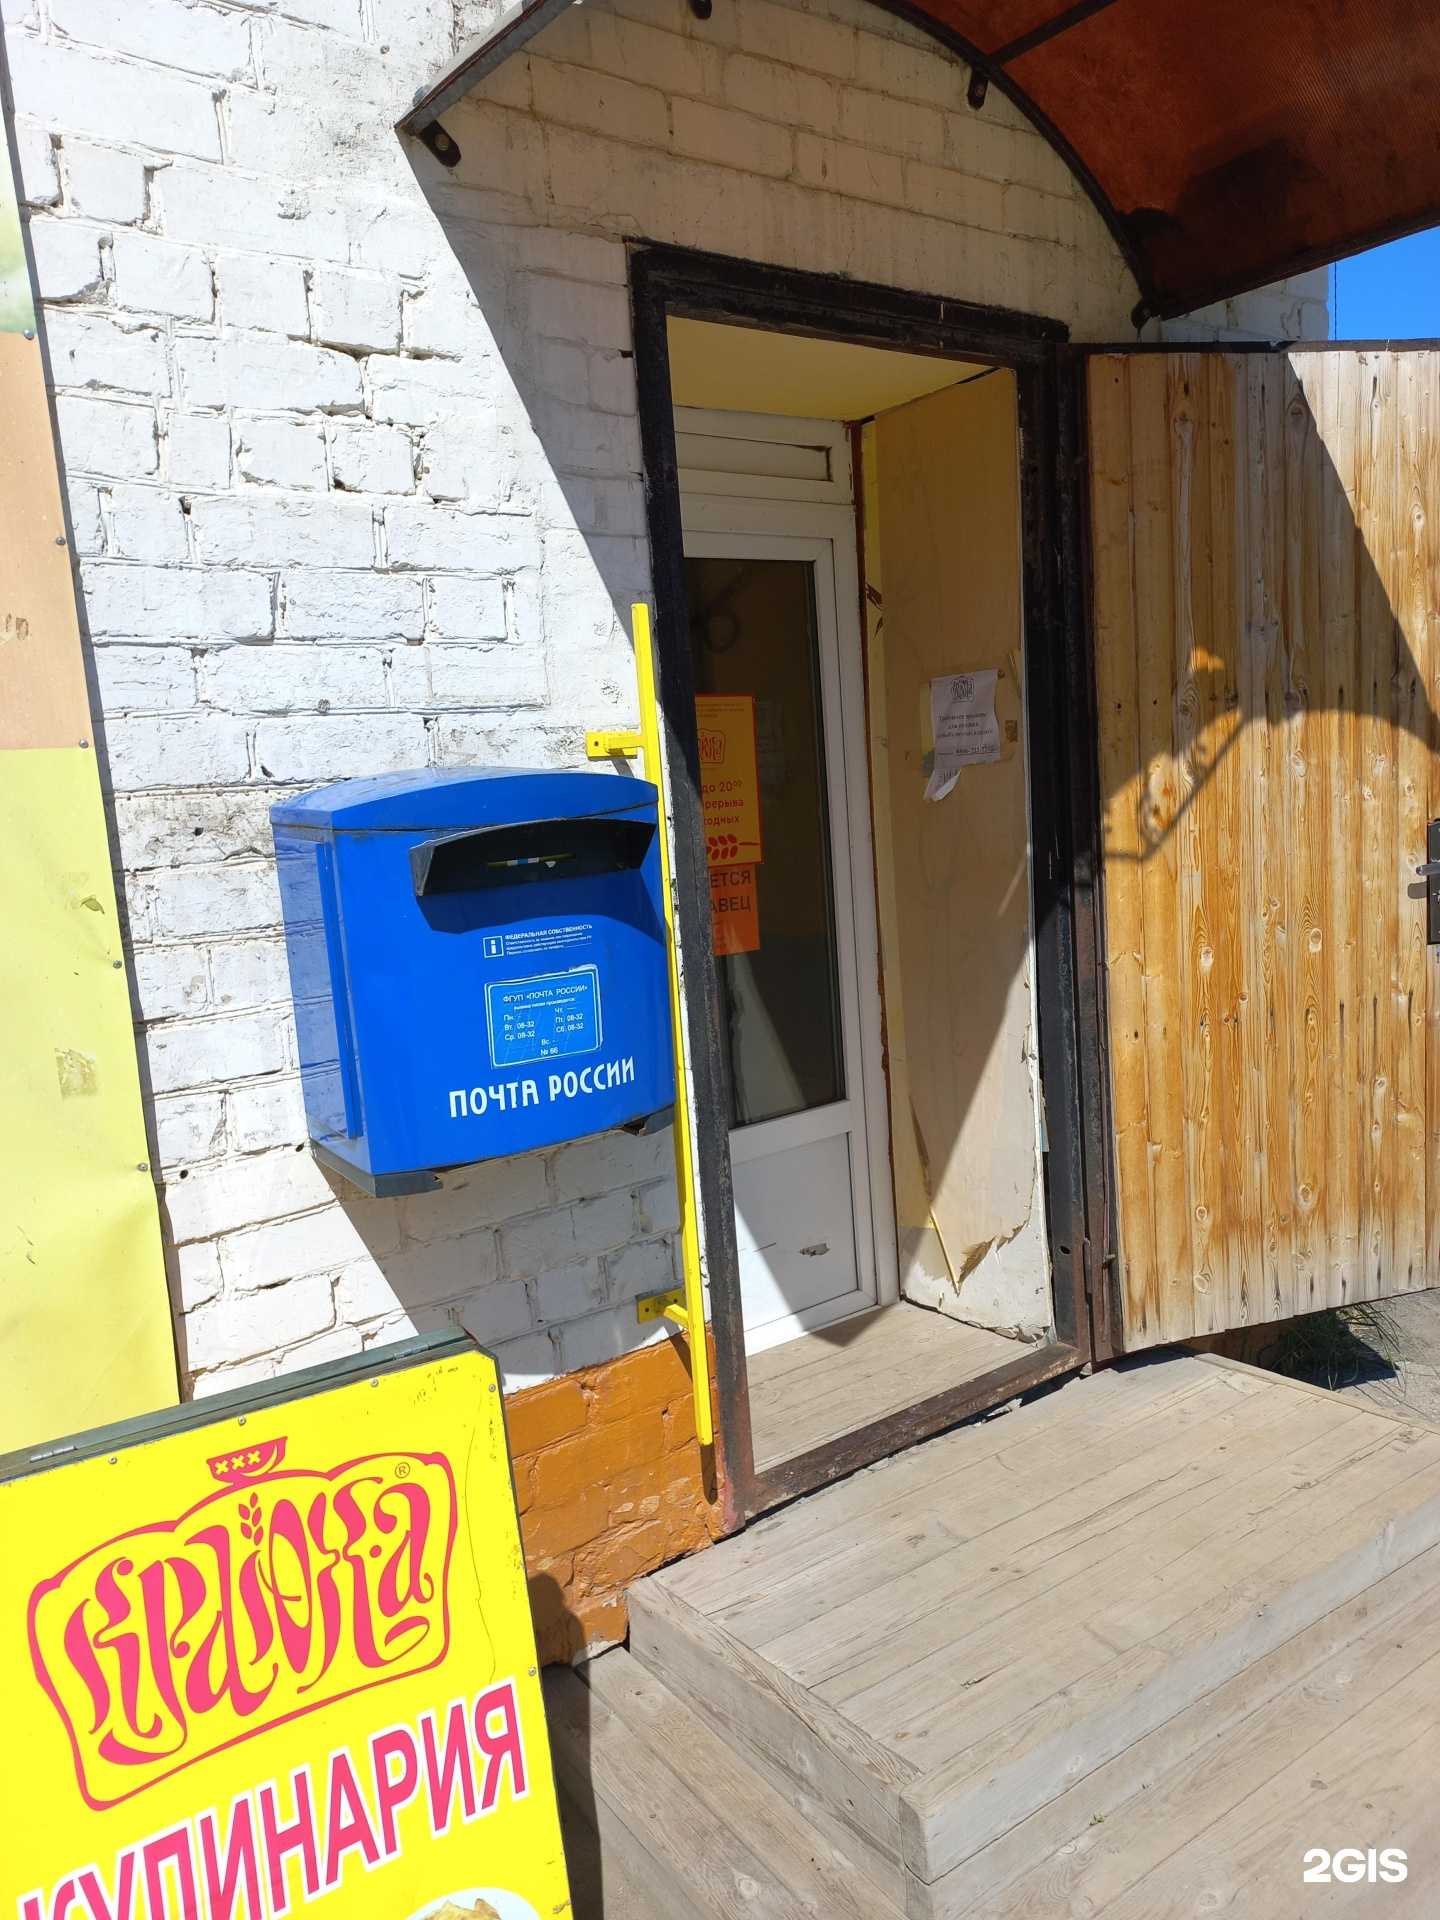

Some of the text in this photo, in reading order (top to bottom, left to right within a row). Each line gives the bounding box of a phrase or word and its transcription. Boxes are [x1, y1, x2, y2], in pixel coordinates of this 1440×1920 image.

[505, 928, 547, 940] ФЕДЕРАЛЬНАЯ
[548, 924, 592, 936] СОБСТВЕННОСТЬ
[503, 994, 524, 1003] ФГУП
[449, 1056, 635, 1118] ПОЧТА РОССИИ
[22, 1682, 526, 1920] УЛИНАРИЯ
